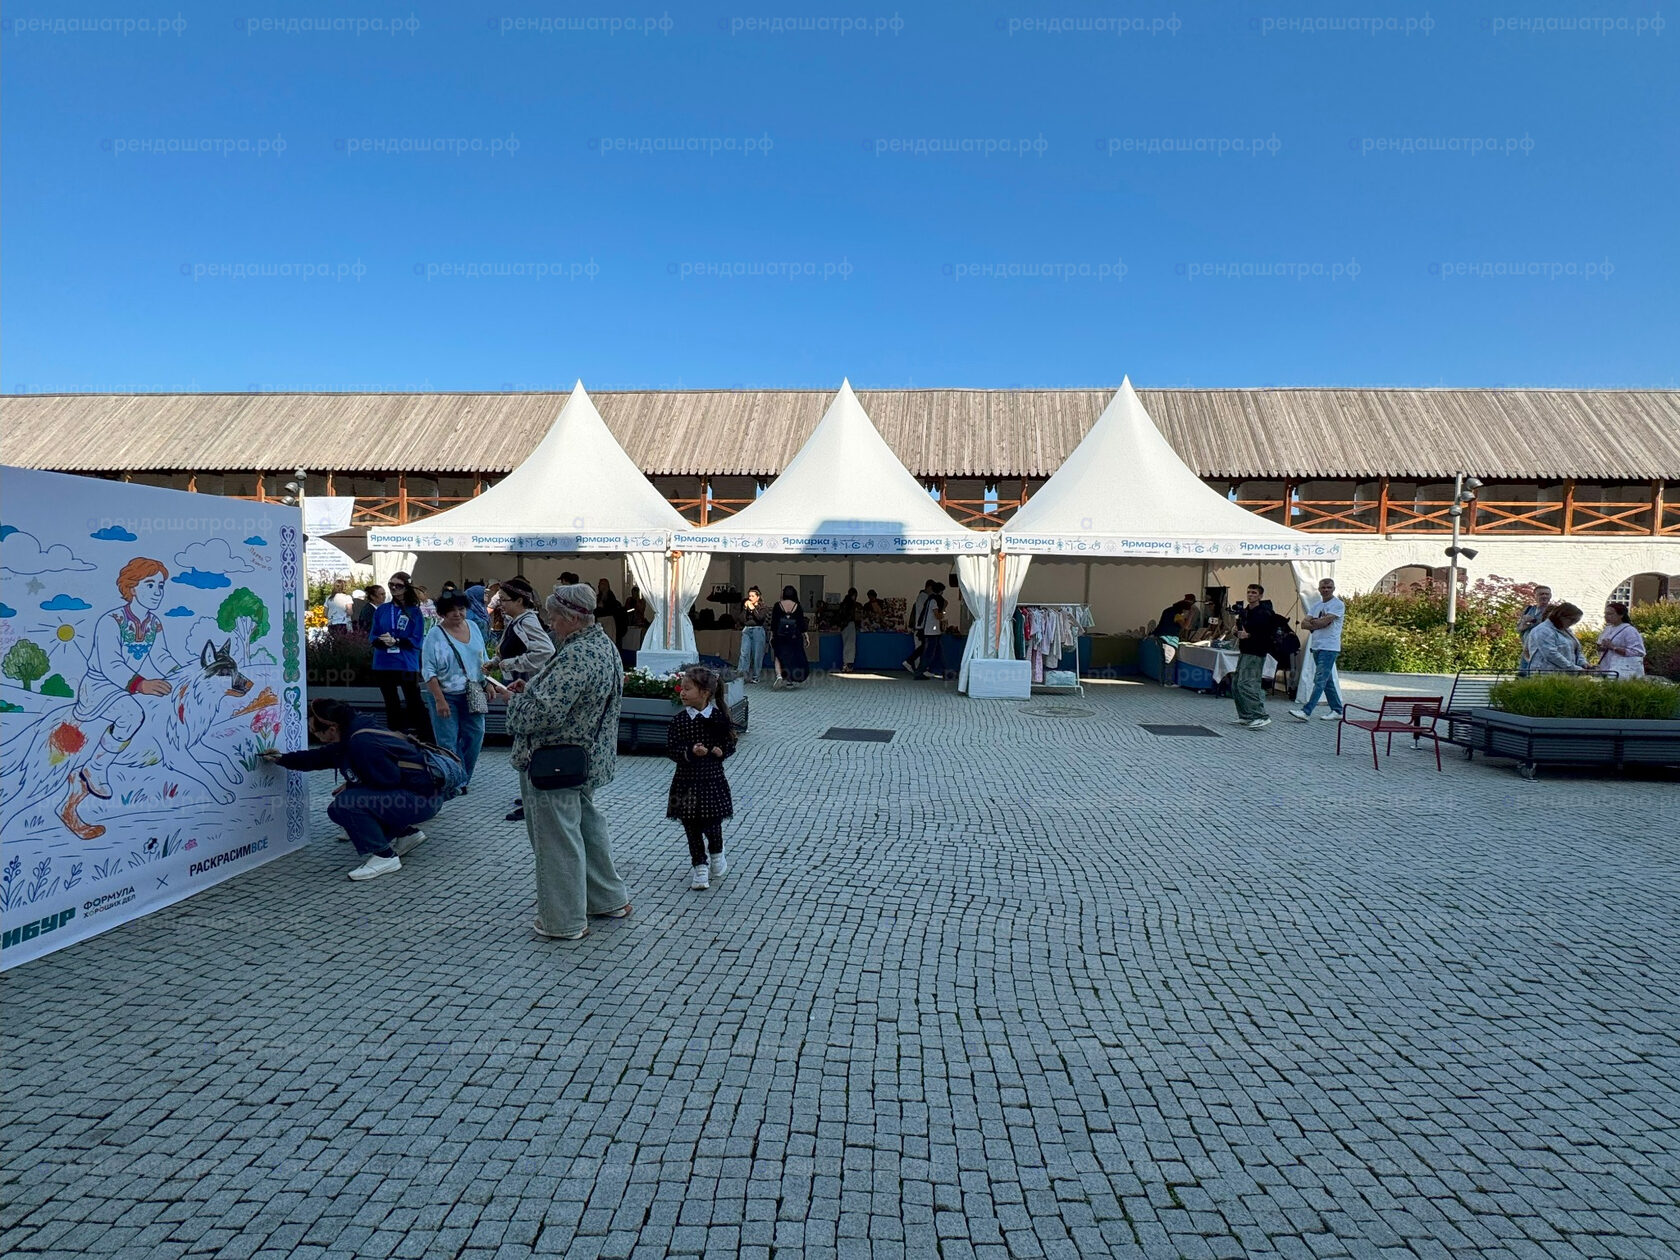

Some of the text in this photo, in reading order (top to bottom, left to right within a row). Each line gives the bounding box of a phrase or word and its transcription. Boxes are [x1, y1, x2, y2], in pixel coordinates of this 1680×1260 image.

[370, 534, 414, 543] Ярмарка
[471, 535, 516, 544] Ярмарка
[575, 535, 621, 544] Ярмарка
[673, 534, 720, 544] Ярмарка
[782, 537, 830, 546] Ярмарка
[893, 537, 943, 546] Ярмарка
[1005, 536, 1055, 546] Ярмарка
[1121, 539, 1172, 549] Ярмарка
[1239, 541, 1292, 551] Ярмарка
[83, 886, 135, 910] ФОРМУЛА
[83, 894, 136, 919] ХОРОШИХ ДЕЛ
[0, 907, 76, 950] ИБУР
